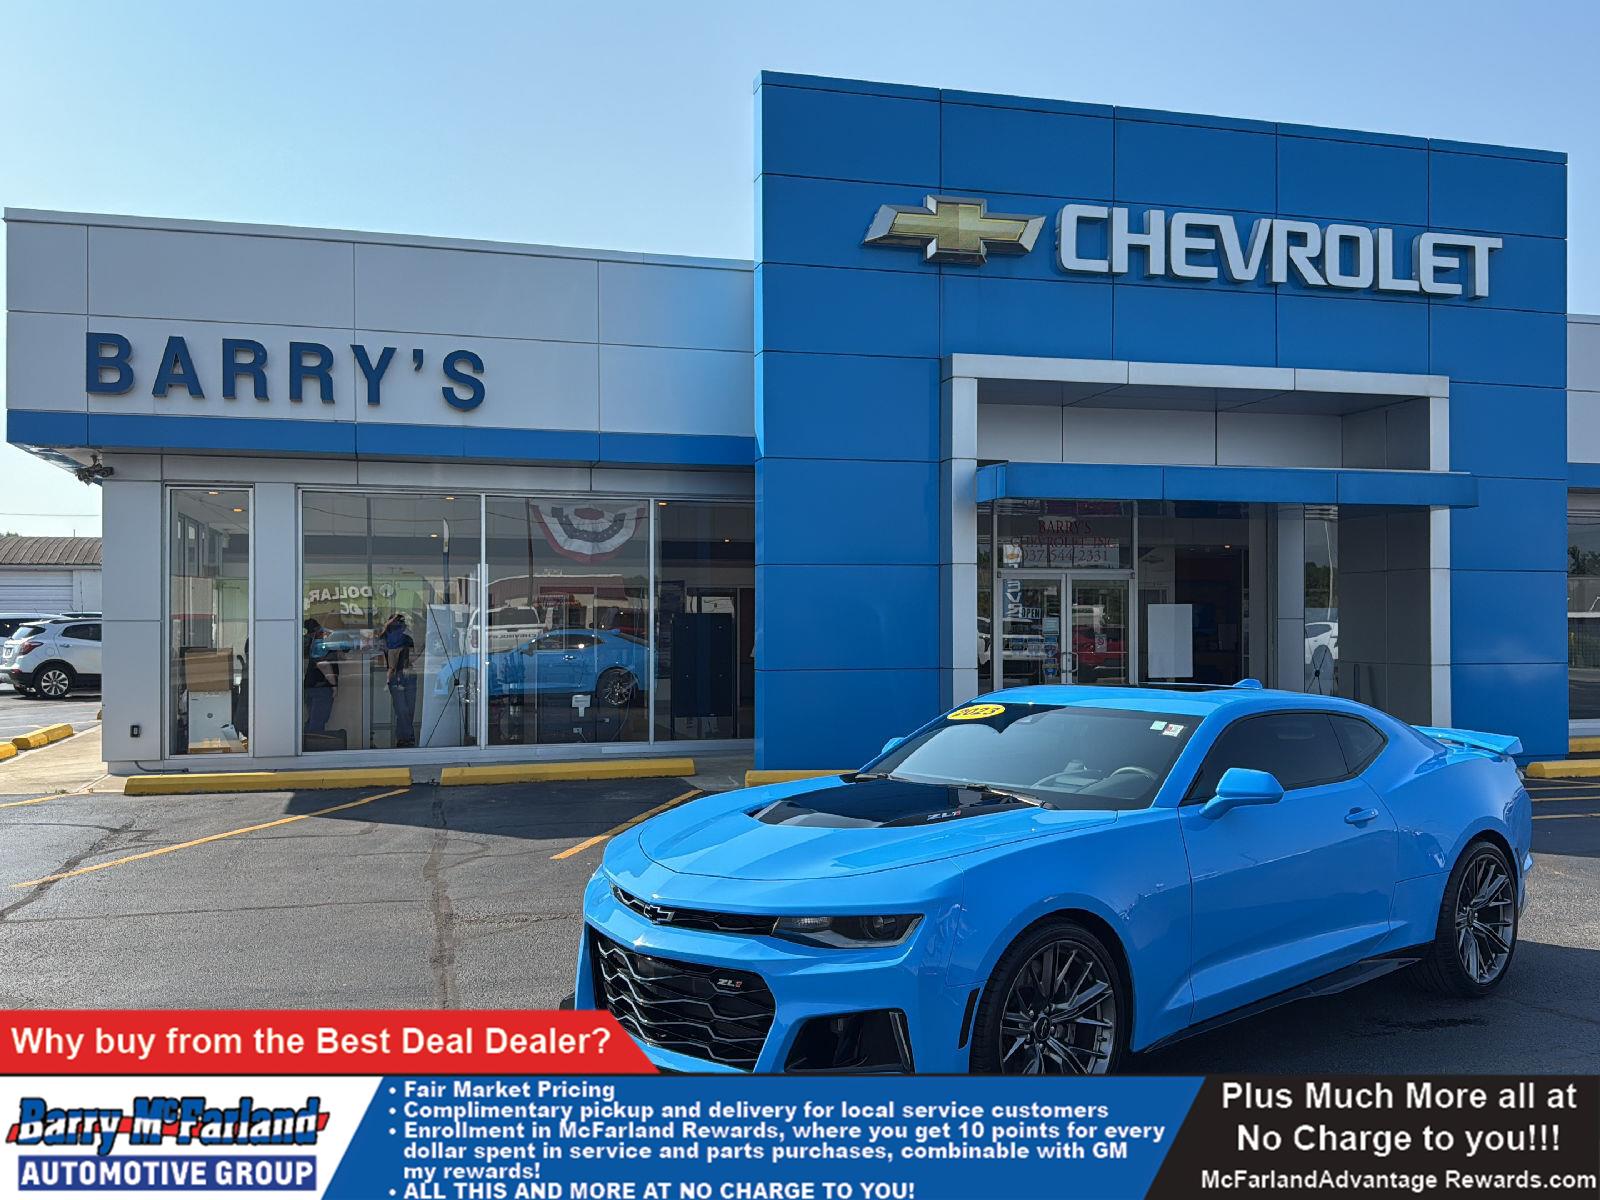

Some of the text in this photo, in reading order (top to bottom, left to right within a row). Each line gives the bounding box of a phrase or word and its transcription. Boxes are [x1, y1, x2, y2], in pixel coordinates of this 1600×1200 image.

[1056, 203, 1503, 299] CHEVROLET
[85, 331, 487, 413] BARRY'S
[1022, 608, 1040, 619] OPEN
[951, 707, 1001, 718] 2023
